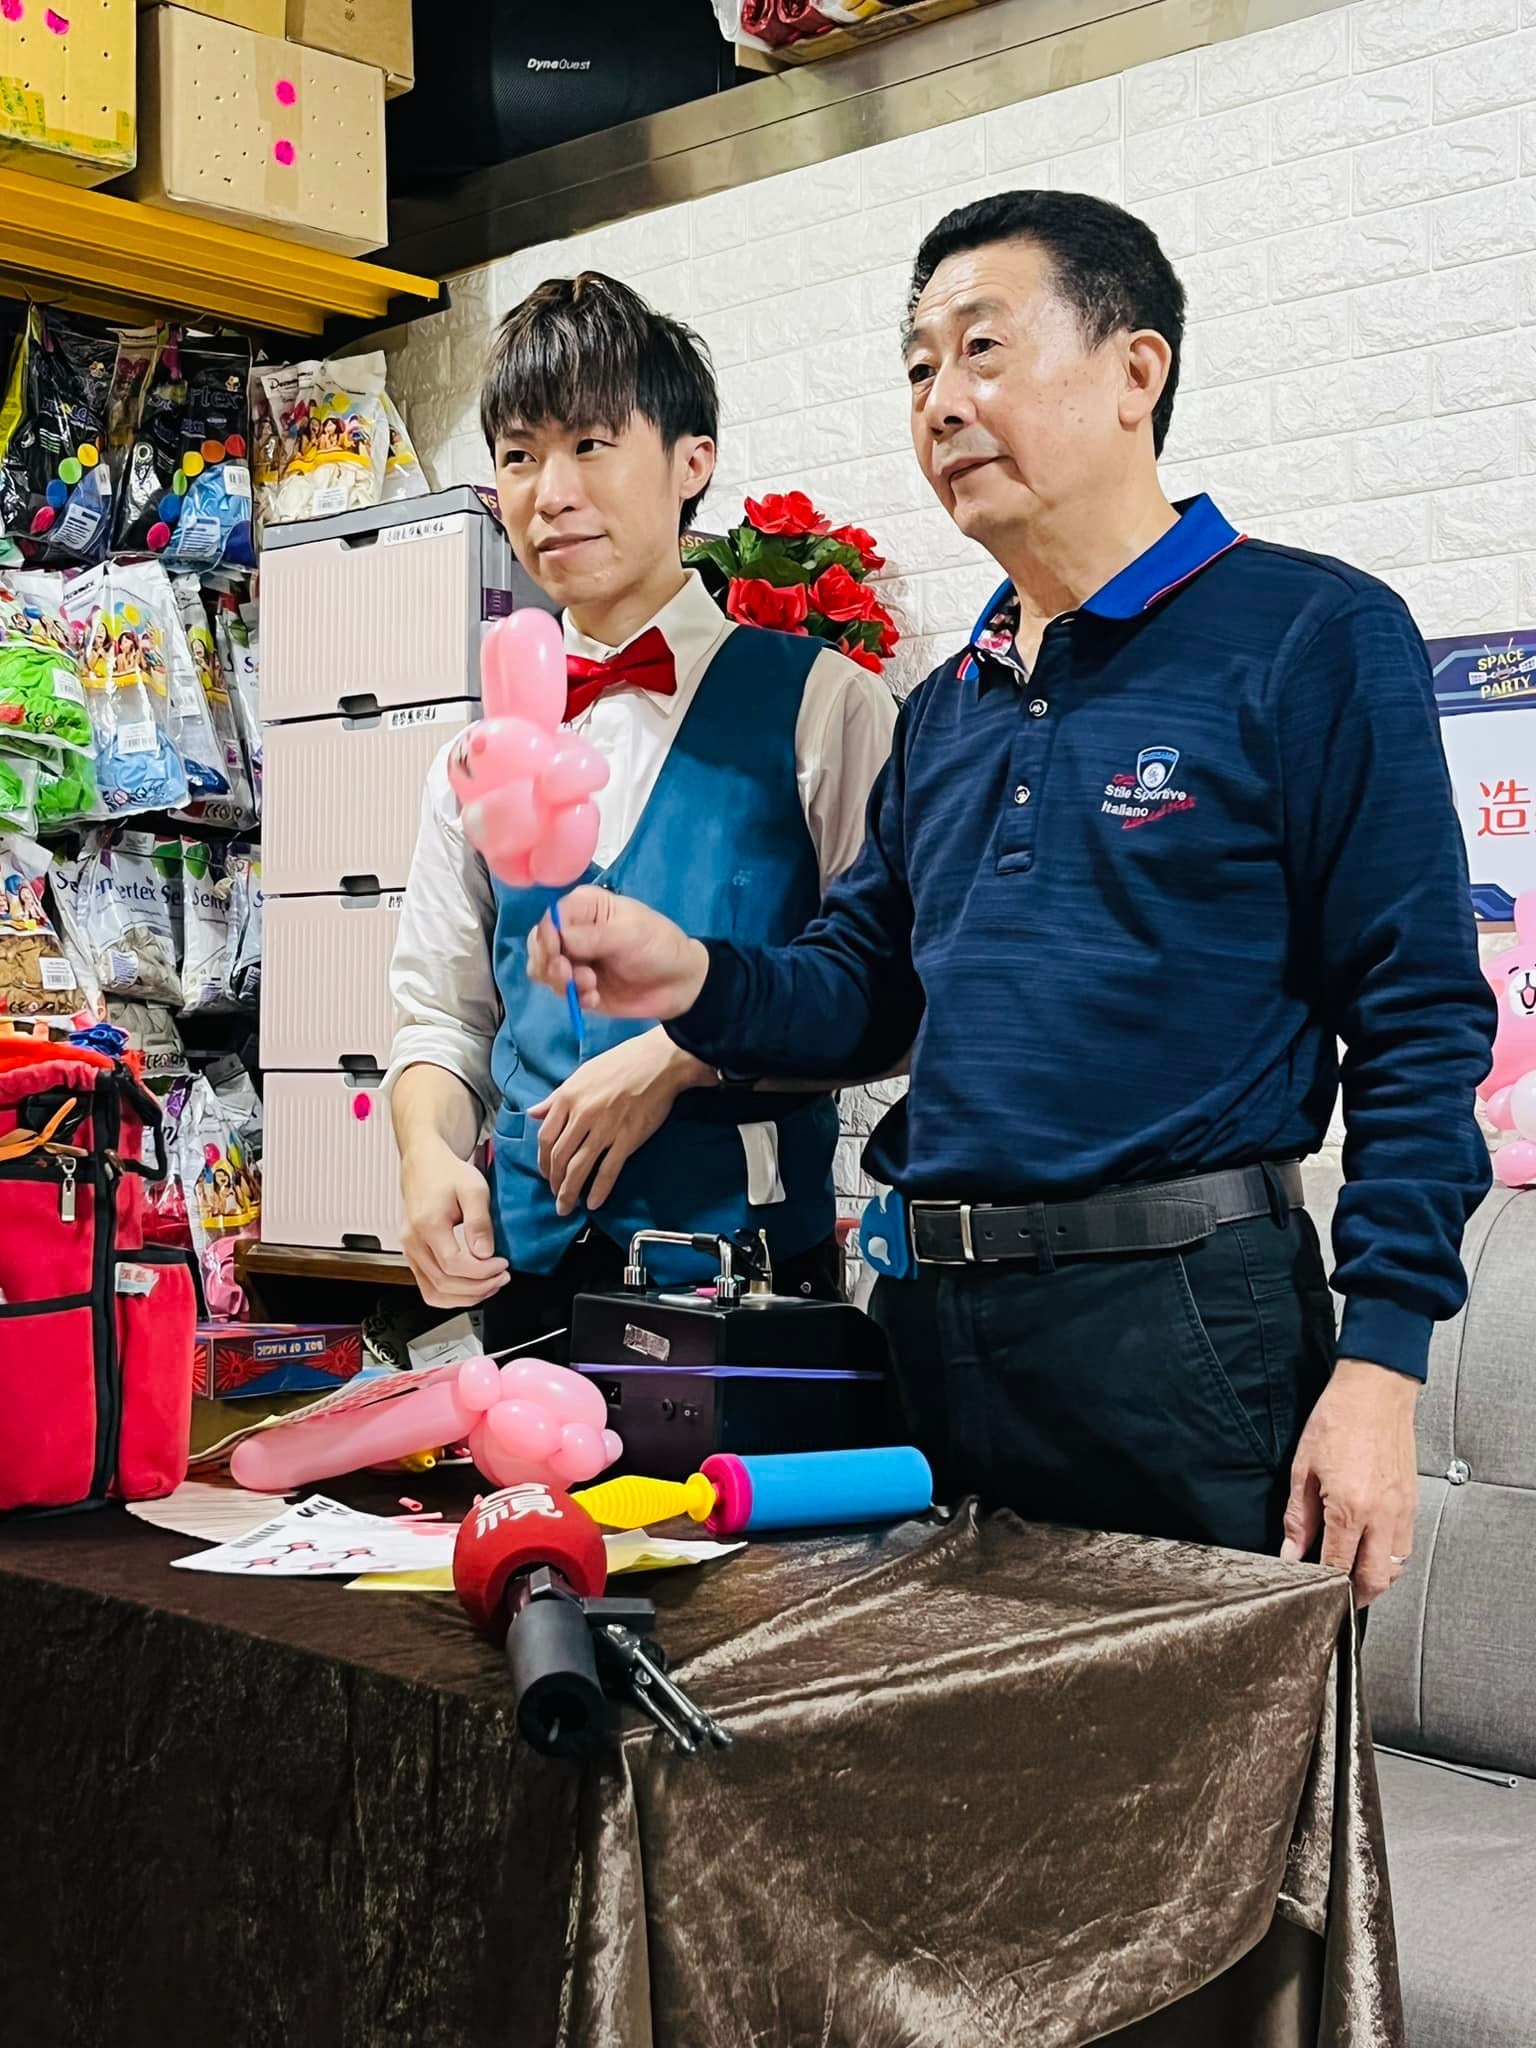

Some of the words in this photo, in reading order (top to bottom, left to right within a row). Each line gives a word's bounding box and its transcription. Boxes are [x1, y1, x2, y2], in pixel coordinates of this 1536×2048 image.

[527, 58, 591, 72] DynaQuest
[1477, 648, 1526, 671] SPACE
[1481, 674, 1531, 699] PARTY
[1104, 784, 1133, 799] Stile
[1101, 800, 1149, 817] Italiano
[1477, 779, 1531, 836] 造
